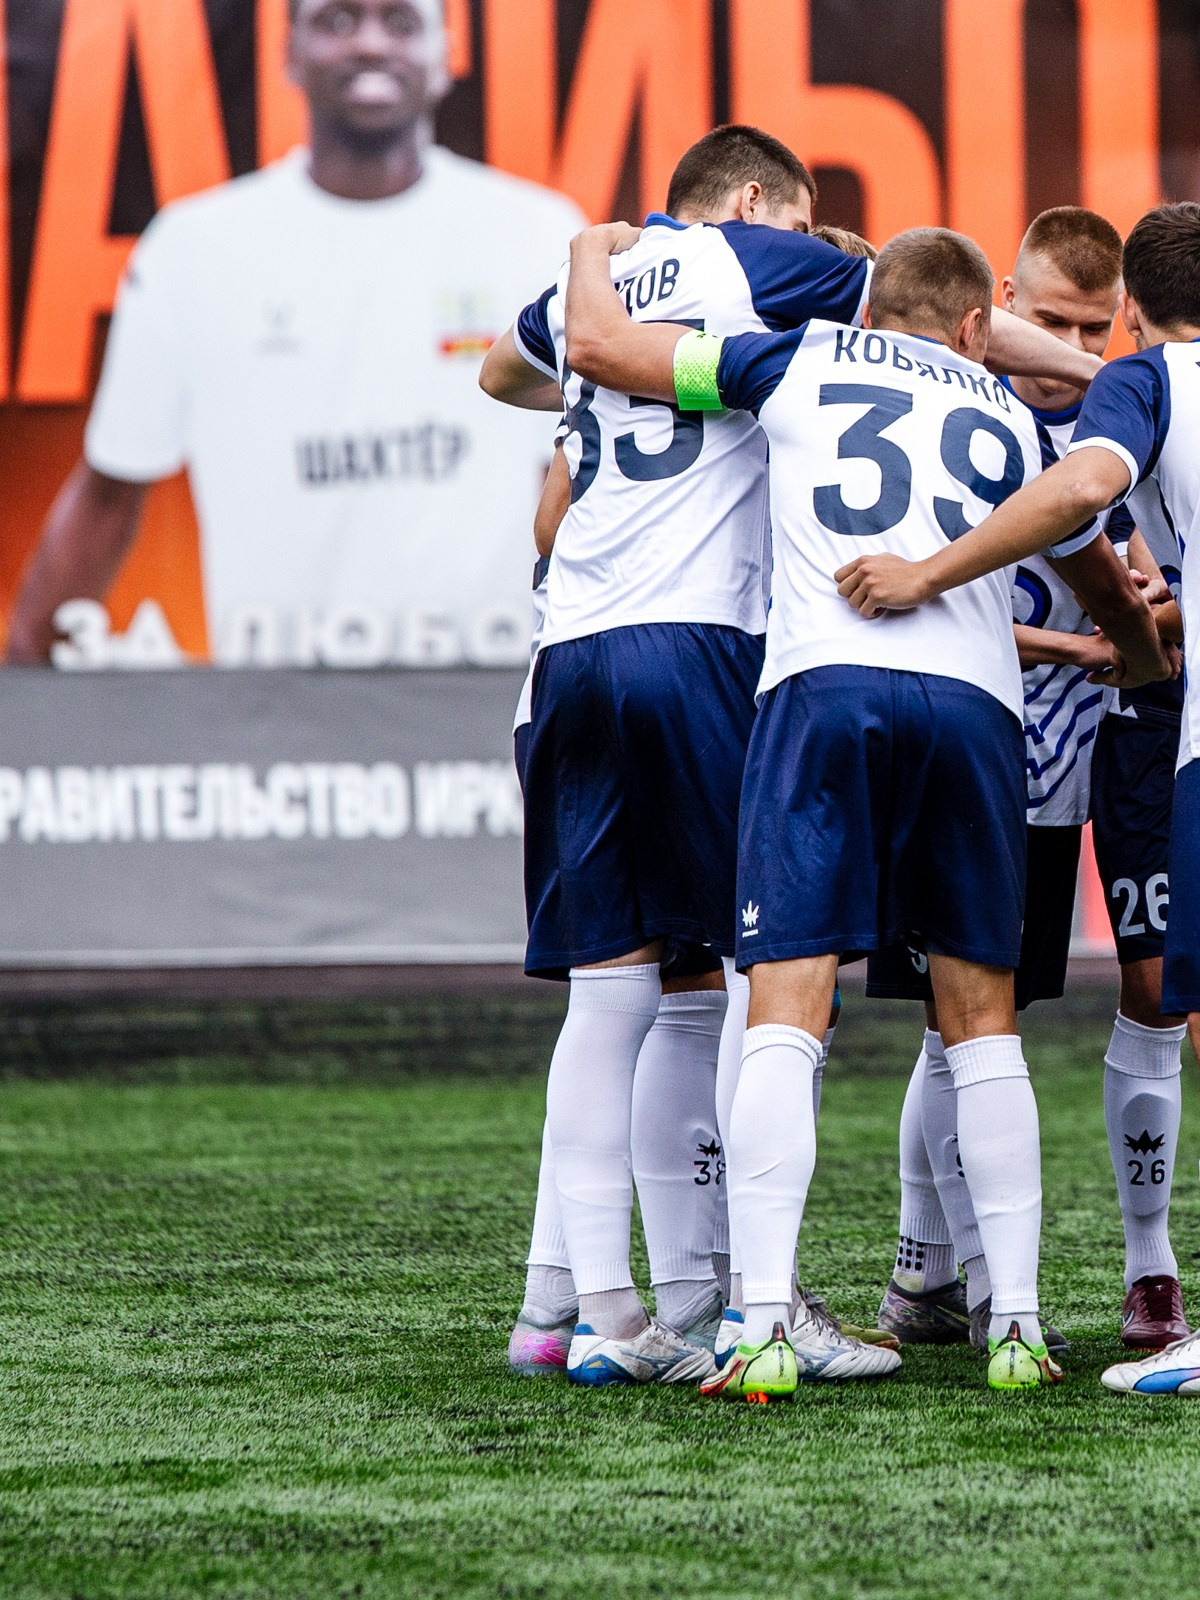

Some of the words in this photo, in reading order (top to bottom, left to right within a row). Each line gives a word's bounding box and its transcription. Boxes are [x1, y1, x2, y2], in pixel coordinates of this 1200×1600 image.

[813, 383, 1026, 544] 39
[53, 598, 184, 668] ЗА
[1112, 873, 1170, 937] 26
[1127, 1158, 1166, 1186] 26
